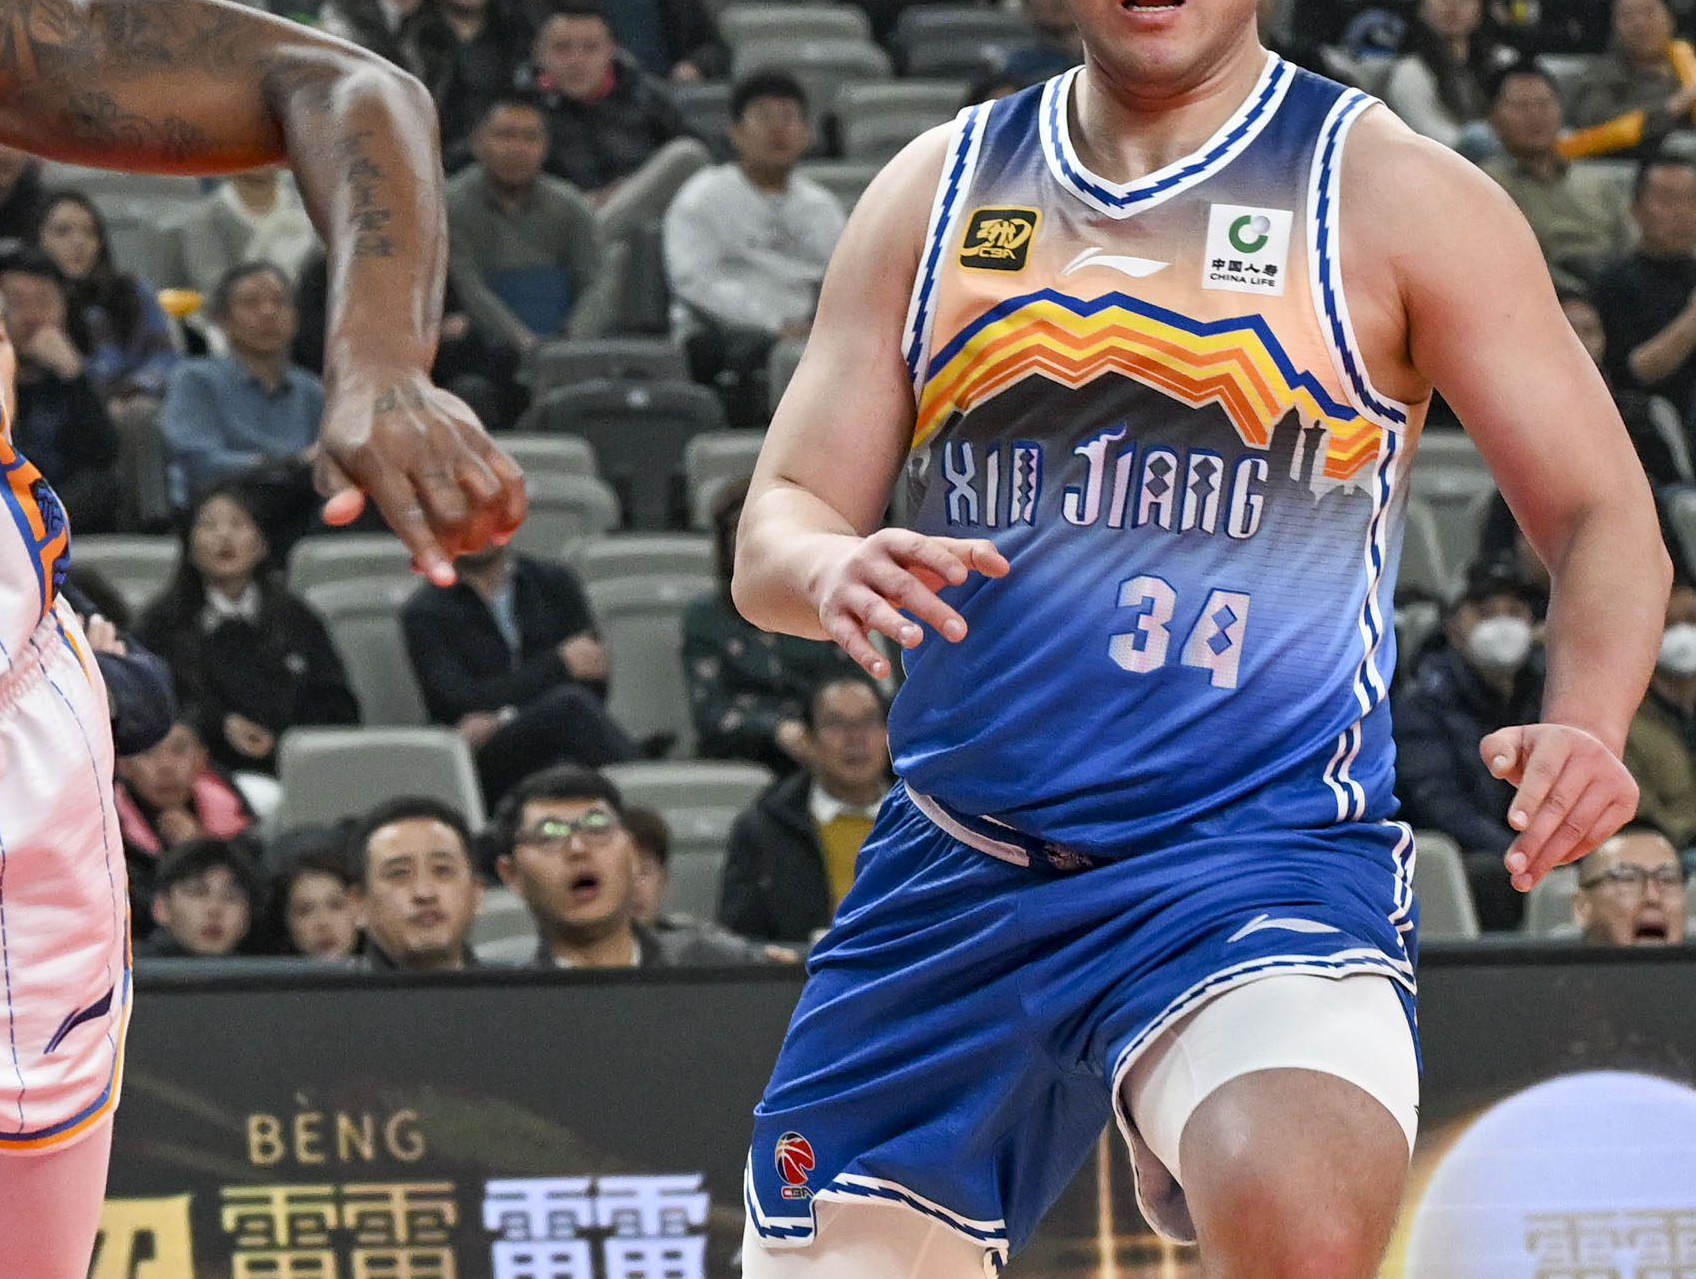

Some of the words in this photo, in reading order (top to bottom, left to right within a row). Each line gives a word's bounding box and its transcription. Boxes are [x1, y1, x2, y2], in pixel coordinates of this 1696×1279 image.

[1209, 272, 1247, 284] CHINA
[1250, 277, 1276, 288] LIFE
[1211, 258, 1278, 278] 中国人寿
[1061, 421, 1269, 540] JIANG
[1108, 574, 1251, 690] 34
[246, 1093, 427, 1165] BÈNG
